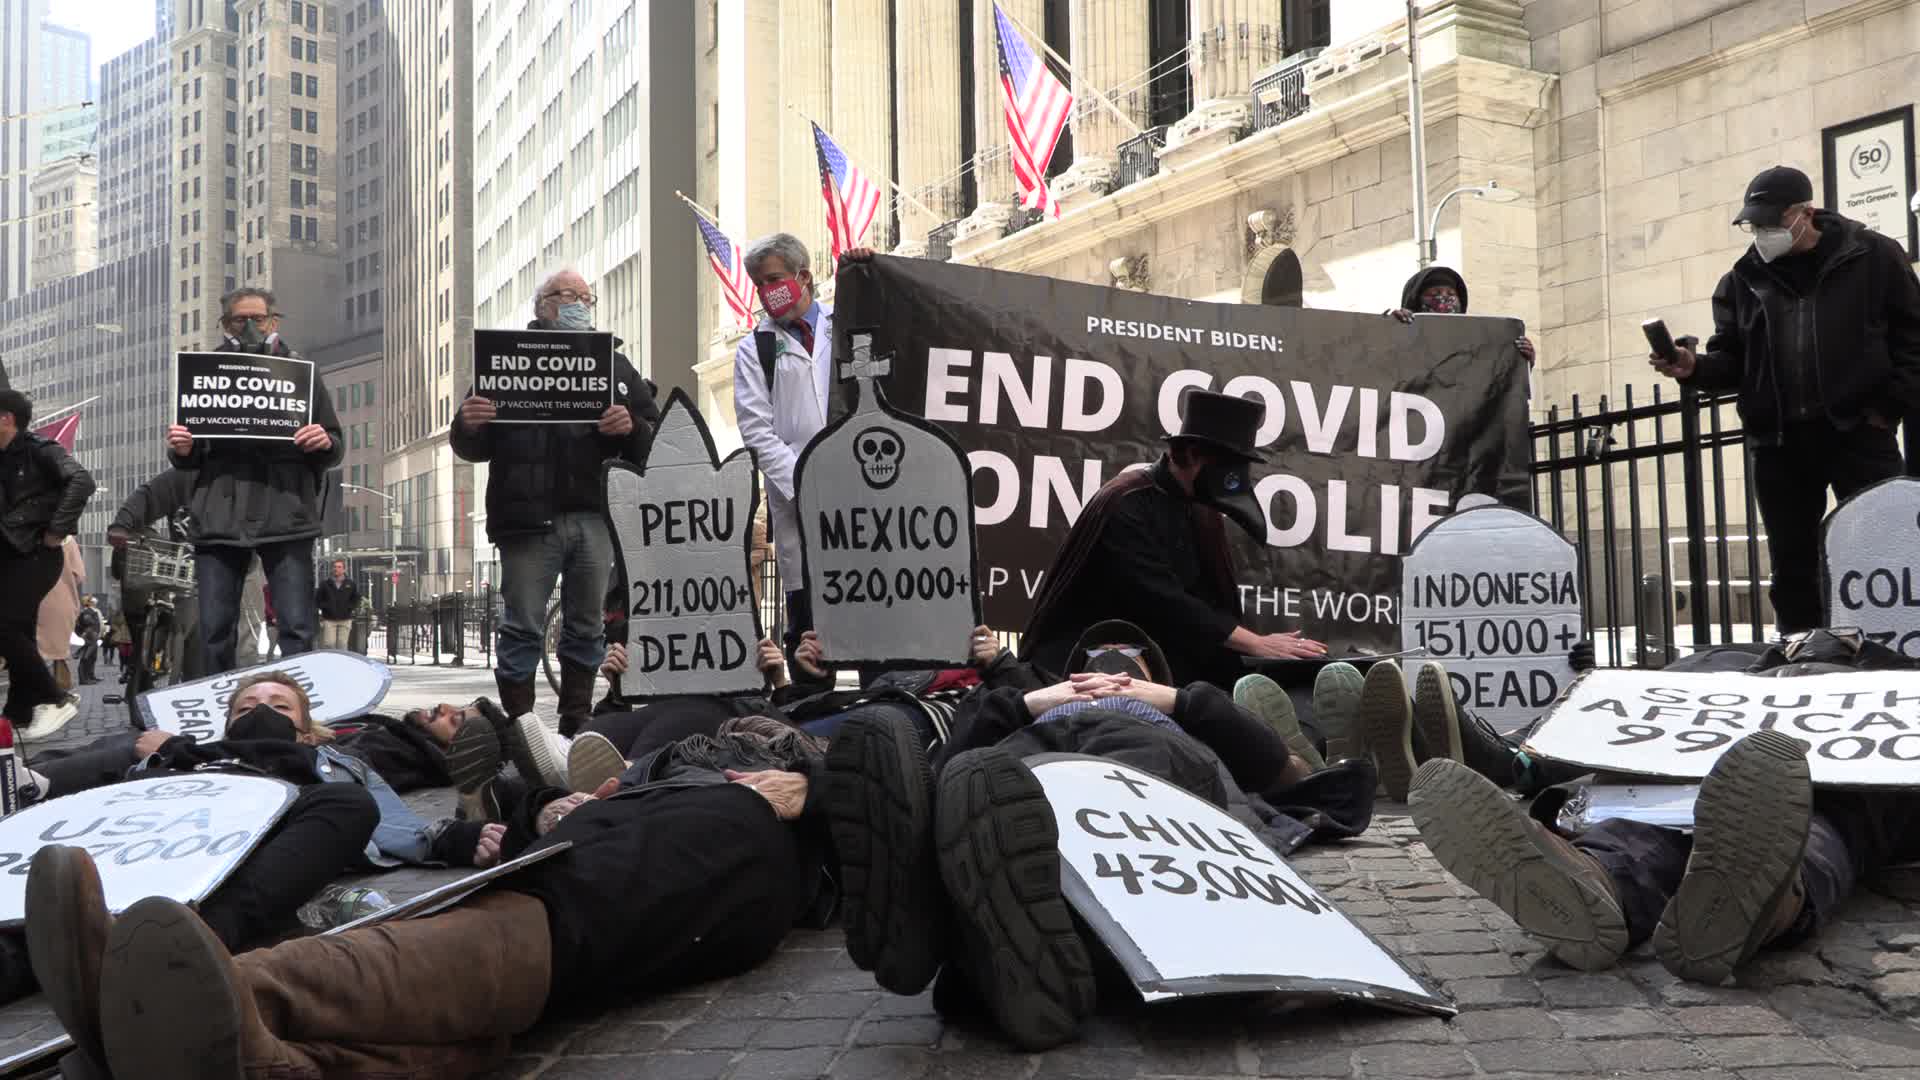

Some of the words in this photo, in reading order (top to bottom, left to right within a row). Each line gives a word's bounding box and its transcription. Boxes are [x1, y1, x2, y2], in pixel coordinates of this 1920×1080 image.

[1858, 147, 1882, 166] 50
[1087, 316, 1203, 345] PRESIDENT
[1211, 330, 1284, 352] BIDEN:
[491, 355, 531, 371] END
[536, 356, 596, 372] COVID
[193, 375, 231, 390] END
[236, 377, 296, 394] COVID
[479, 375, 608, 392] MONOPOLIES
[181, 394, 307, 413] MONOPOLIES
[490, 400, 506, 408] ELP
[507, 400, 553, 409] VACCINATE
[554, 401, 571, 409] THE
[572, 401, 603, 409] WORLD
[924, 347, 1125, 433] END
[1157, 369, 1446, 462] COVID
[185, 417, 206, 425] HELP
[207, 416, 251, 425] VACCINATE
[252, 417, 268, 425] THE
[269, 418, 301, 428] WORLD
[638, 497, 734, 547] PERU
[819, 505, 958, 552] MEXICO
[631, 576, 751, 617] 211,000+
[822, 566, 970, 608] 320,000+
[1237, 584, 1301, 618] THE
[1413, 570, 1578, 608] INDONESIA
[638, 629, 747, 673] DEAD
[1414, 618, 1577, 660] 151,000+
[1579, 698, 1911, 734] AFRICA
[38, 807, 210, 842] USA
[1075, 807, 1275, 867] CHILE
